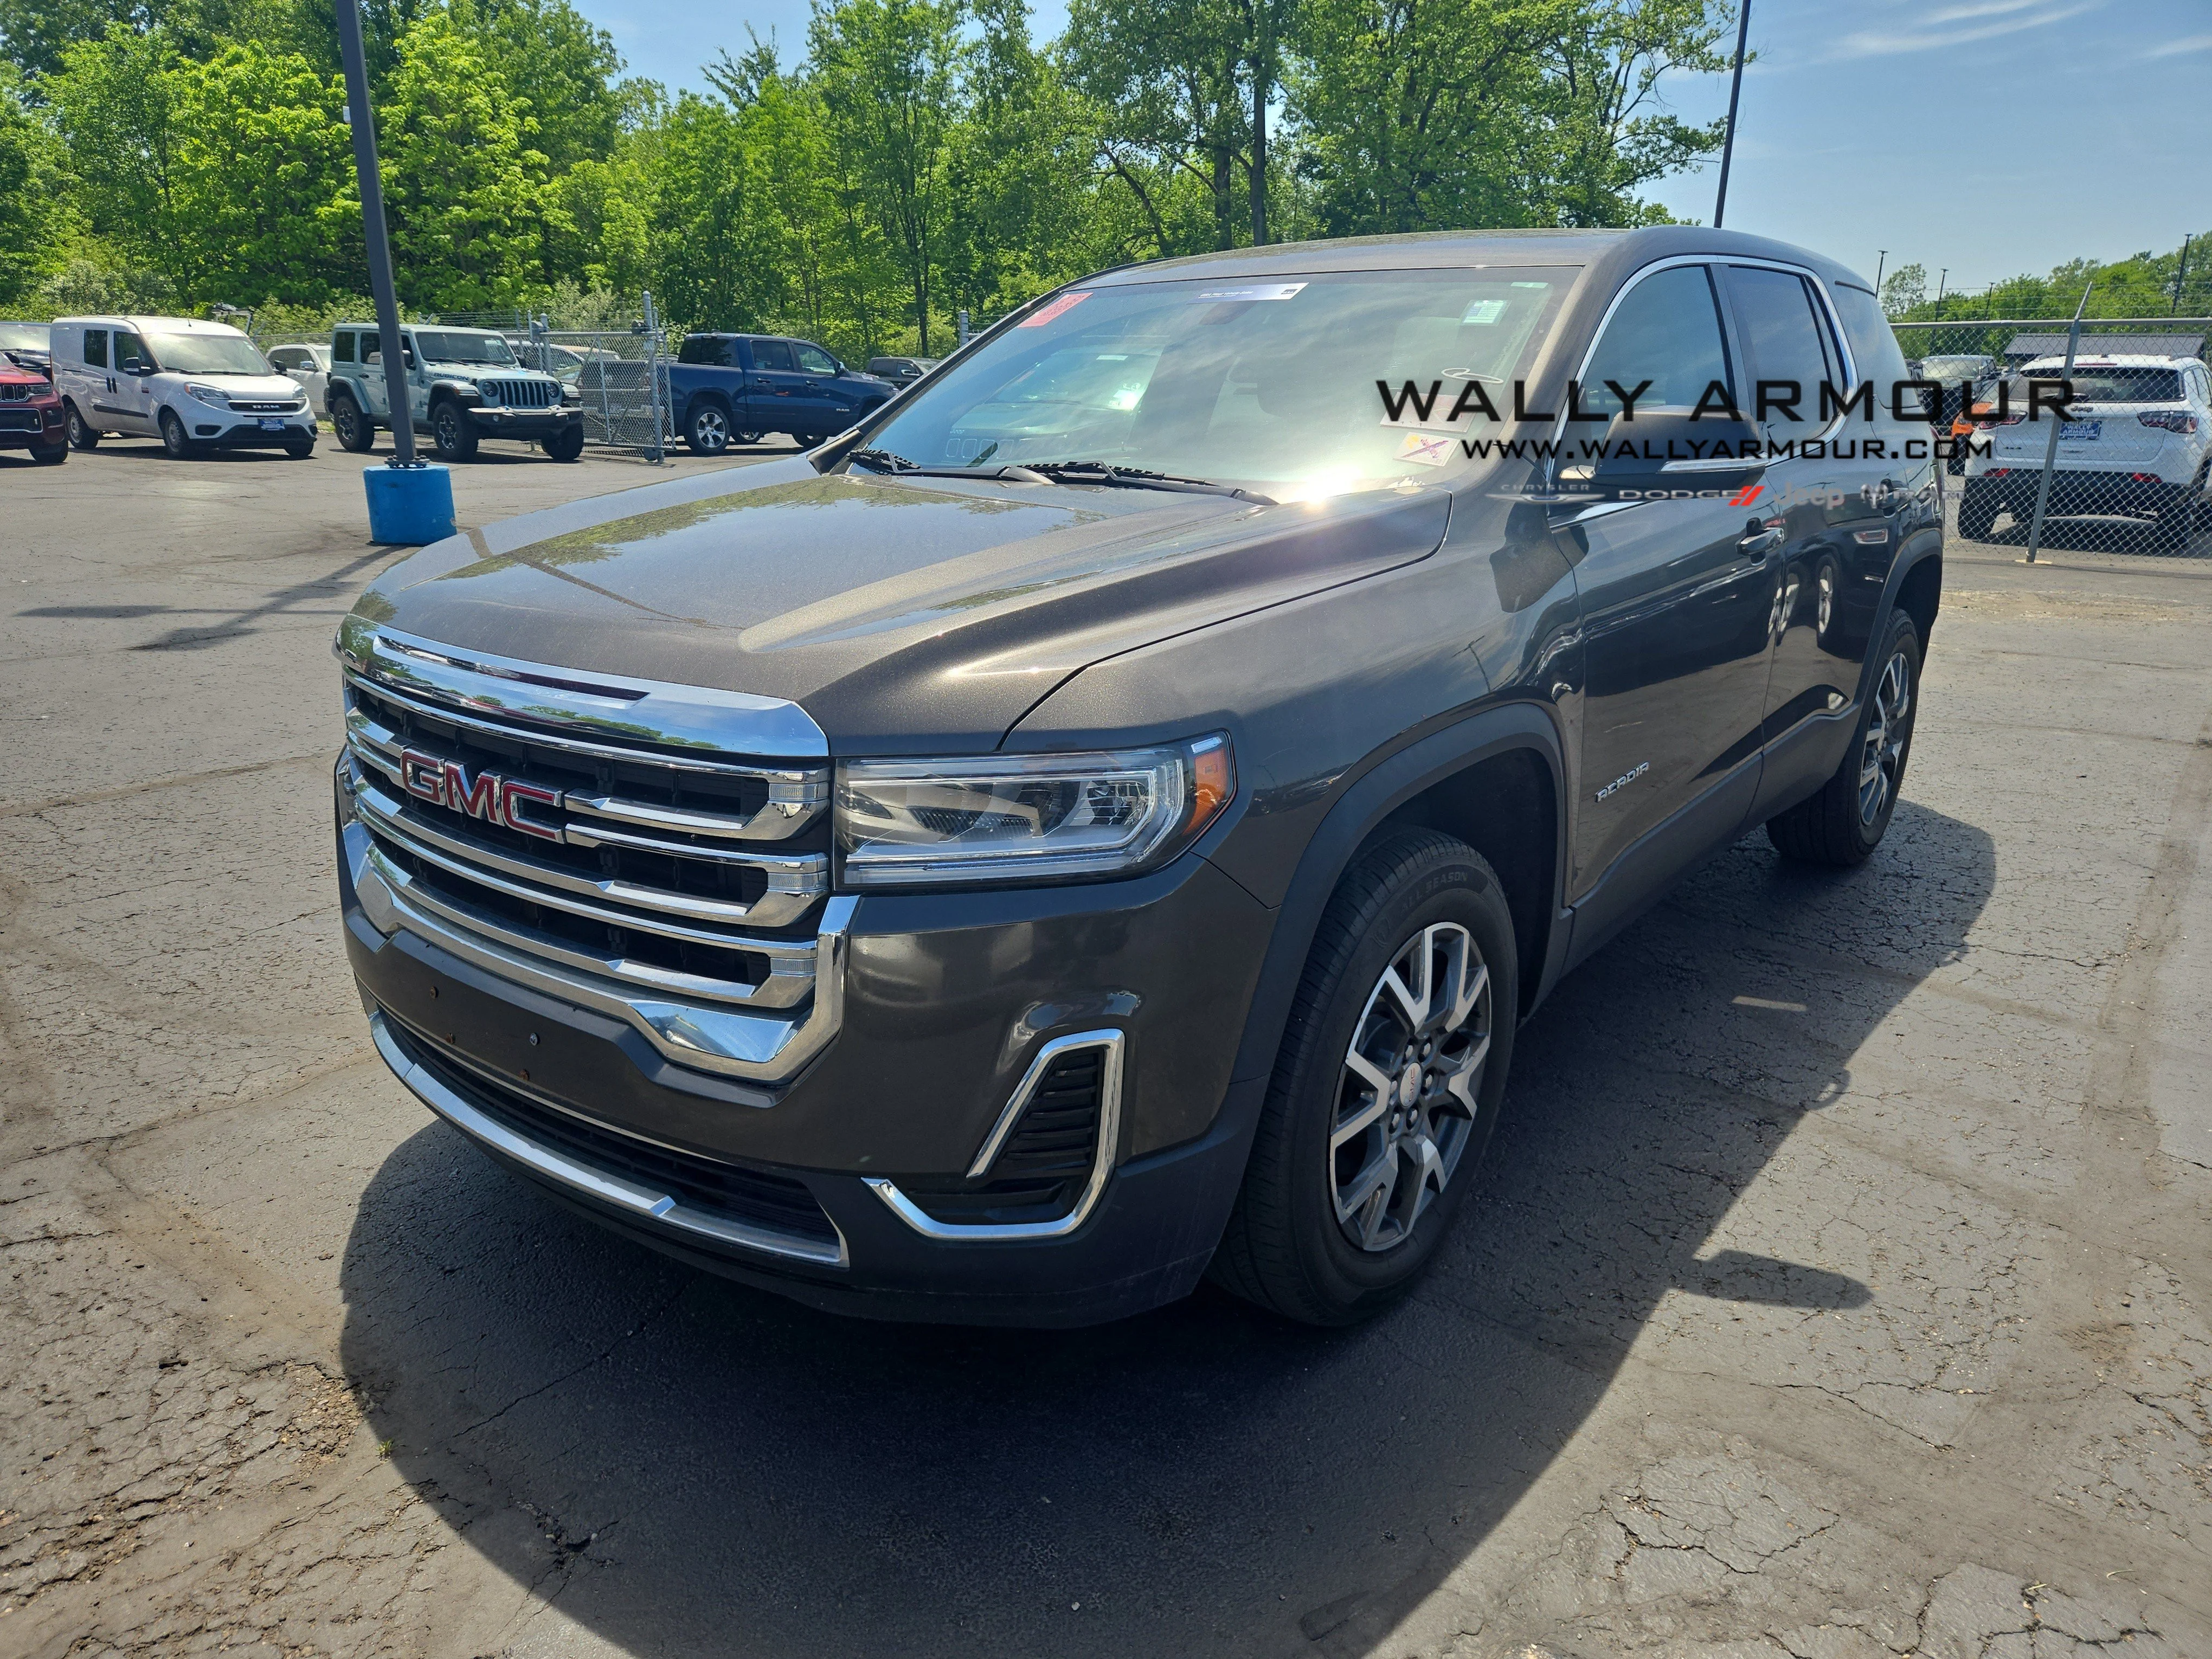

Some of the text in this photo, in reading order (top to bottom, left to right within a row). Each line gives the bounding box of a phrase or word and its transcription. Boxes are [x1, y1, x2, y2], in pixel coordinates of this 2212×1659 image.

[434, 372, 470, 380] RUBICON
[401, 748, 565, 844] GMC
[1596, 761, 1649, 802] ACADIA
[1425, 871, 1469, 891] SEASON
